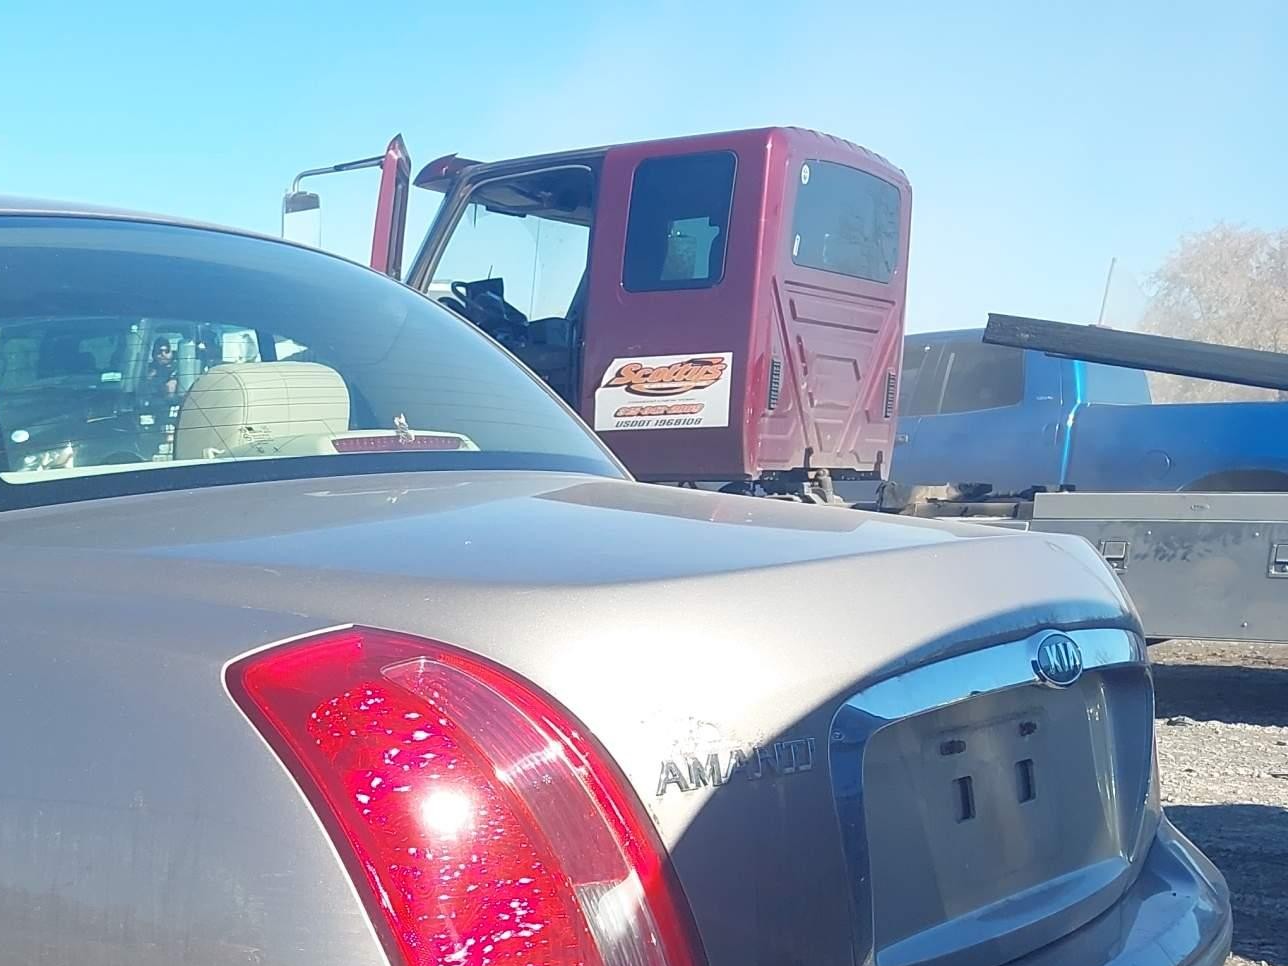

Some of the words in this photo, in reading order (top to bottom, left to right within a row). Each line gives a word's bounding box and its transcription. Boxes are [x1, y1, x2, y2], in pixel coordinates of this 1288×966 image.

[615, 419, 651, 428] USDOT
[1043, 640, 1081, 675] KIA
[656, 737, 816, 797] AMANTI
